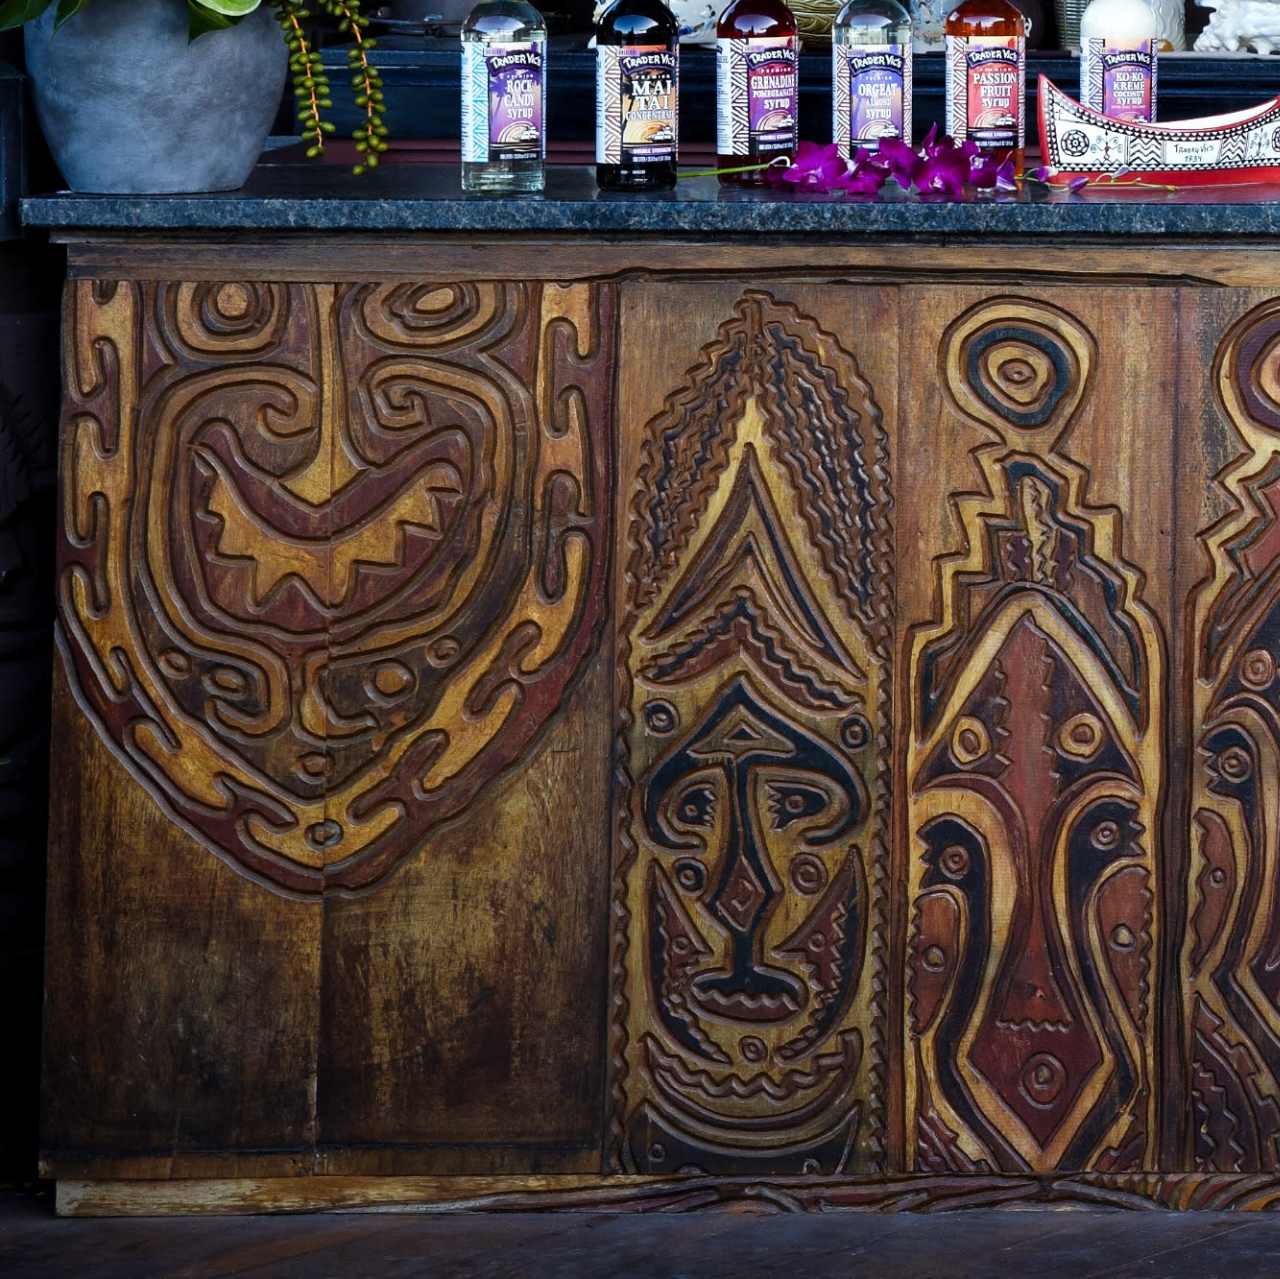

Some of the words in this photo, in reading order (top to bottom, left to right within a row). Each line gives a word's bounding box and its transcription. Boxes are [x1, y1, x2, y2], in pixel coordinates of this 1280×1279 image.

[490, 54, 526, 69] TRADER
[623, 55, 660, 69] TRADER
[749, 50, 782, 64] TRADER
[851, 55, 886, 70] TRADER
[969, 50, 1002, 63] TRADER
[1104, 53, 1137, 65] TRADER
[973, 72, 1018, 85] PASSION
[506, 79, 533, 93] ROCK
[631, 79, 672, 96] MAI
[858, 83, 898, 97] ORGEAT
[980, 85, 1013, 97] FRUIT
[1113, 81, 1145, 91] KREME
[504, 93, 535, 106] CANDY
[635, 96, 669, 111] TAI
[763, 98, 790, 110] syrup
[982, 97, 1010, 108] syrup
[506, 107, 533, 120] syrup
[865, 108, 892, 120] syrup
